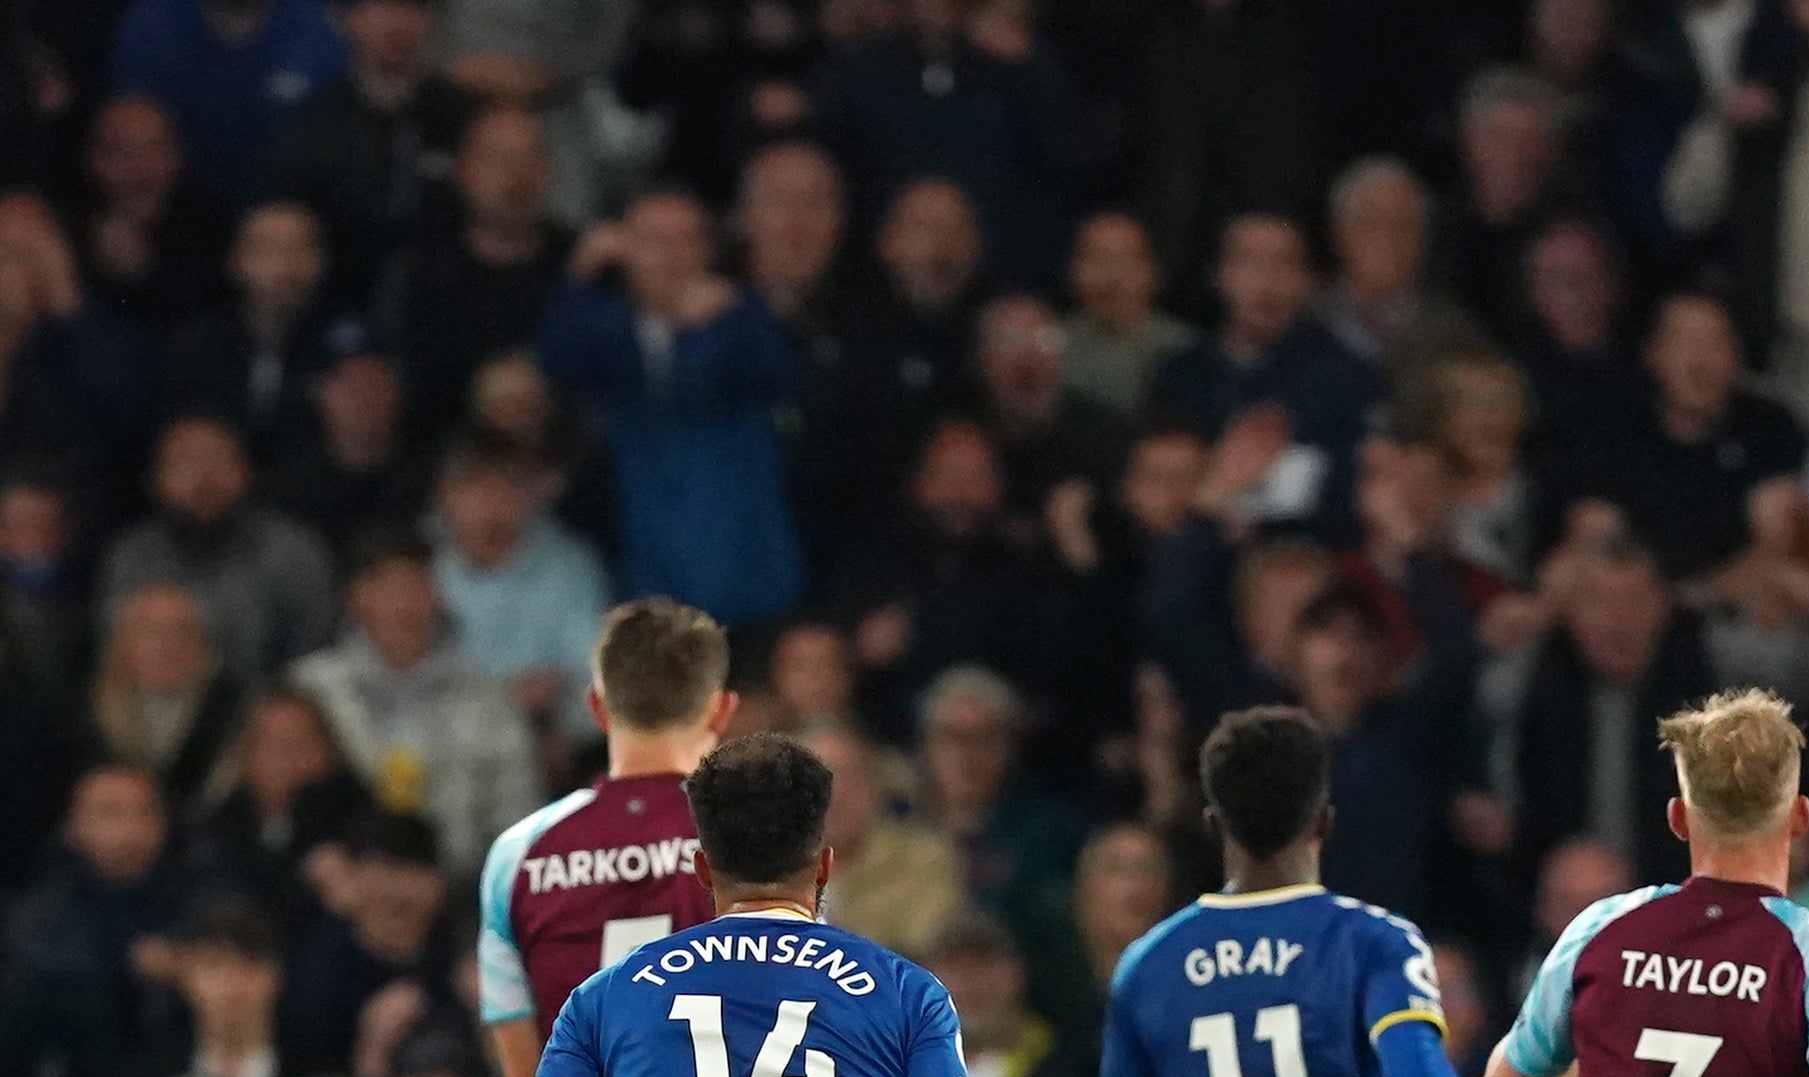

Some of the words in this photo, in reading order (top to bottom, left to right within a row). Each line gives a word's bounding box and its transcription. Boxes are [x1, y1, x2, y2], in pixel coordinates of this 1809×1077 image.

[522, 836, 703, 896] TARKOWS
[632, 934, 877, 999] TOWNSEND
[1184, 937, 1304, 987] GRAY
[1621, 949, 1767, 1003] TAYLOR
